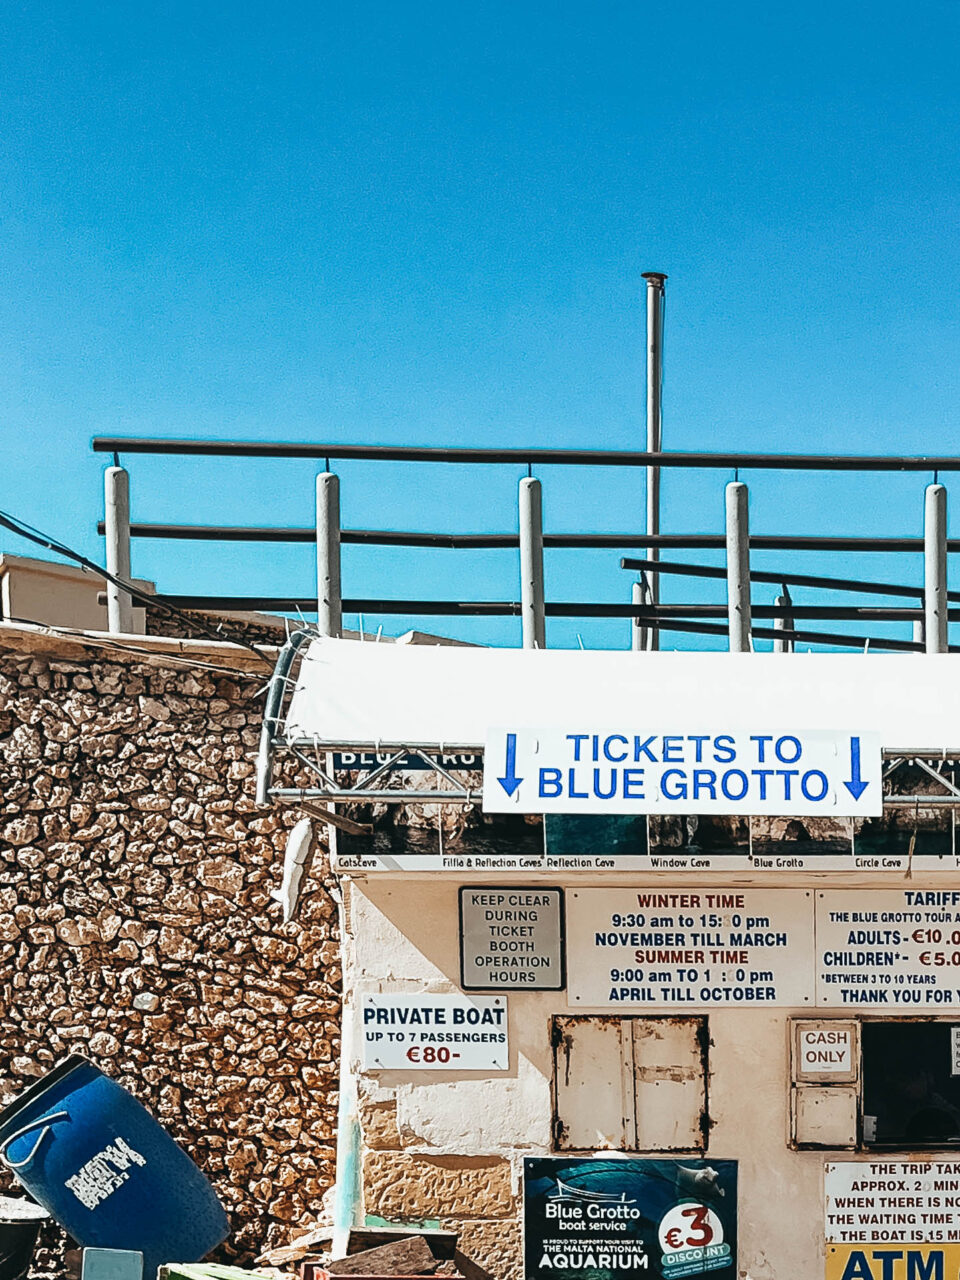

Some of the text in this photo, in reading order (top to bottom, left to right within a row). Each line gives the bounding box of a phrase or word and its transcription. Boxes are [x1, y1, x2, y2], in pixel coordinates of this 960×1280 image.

[566, 735, 803, 763] TICKETS TO
[539, 768, 829, 801] BLUE GROTTO
[466, 858, 472, 868] &
[475, 858, 517, 868] Reflection
[519, 858, 542, 868] Caves
[547, 858, 615, 868] Reflection Cave
[651, 858, 711, 868] Window Cave
[754, 858, 804, 868] Blue Grotto
[855, 858, 901, 868] Circle Cave
[472, 895, 550, 906] KEEP CLEAR
[637, 894, 745, 908] WINTER TIME
[485, 911, 538, 922] DURING
[612, 914, 646, 928] 9:30
[650, 916, 674, 928] am
[678, 914, 694, 928] to
[746, 916, 770, 930] pm
[829, 912, 849, 923] THE
[852, 912, 878, 923] BLUE
[881, 912, 922, 923] GROTTO
[925, 912, 951, 923] TOUR
[489, 926, 535, 937] TICKET
[595, 932, 787, 947] NOVEMBER TILL MARCH
[490, 941, 535, 952] BOOTH
[475, 956, 550, 968] OPERATION
[635, 950, 749, 964] SUMMER TIME
[489, 972, 536, 983] HOURS
[610, 969, 644, 982] 9:00
[648, 971, 672, 982] am
[676, 969, 698, 982] TO
[750, 971, 773, 985] pm
[871, 974, 877, 984] 3
[880, 974, 891, 984] TO
[894, 974, 904, 984] 10
[907, 974, 936, 984] YEARS
[609, 987, 776, 1001] APRIL TILL OCTOBER
[841, 989, 888, 1003] THANK
[892, 989, 921, 1003] YOU
[926, 989, 951, 1003] FOR
[363, 1008, 505, 1025] PRIVATE BOAT
[366, 1032, 506, 1043] UP TO 7 PASSENGERS
[805, 1032, 847, 1045] CASH
[805, 1051, 846, 1063] ONLY
[870, 1164, 896, 1175] THE
[901, 1164, 932, 1175] TRIP
[851, 1181, 910, 1191] APPROX.
[835, 1197, 874, 1208] WHEN
[879, 1197, 923, 1208] THERE
[928, 1197, 940, 1208] IS
[545, 1203, 641, 1219] Blue Grotto
[828, 1214, 854, 1224] THE
[858, 1214, 916, 1224] WAITING
[921, 1214, 953, 1224] TIME
[558, 1220, 627, 1231] boat service
[840, 1230, 867, 1241] THE
[871, 1230, 907, 1241] BOAT
[911, 1230, 923, 1241] IS
[928, 1230, 943, 1241] 15
[543, 1245, 644, 1253] THE MALTA NATIONAL
[538, 1253, 649, 1269] AQUARIUM
